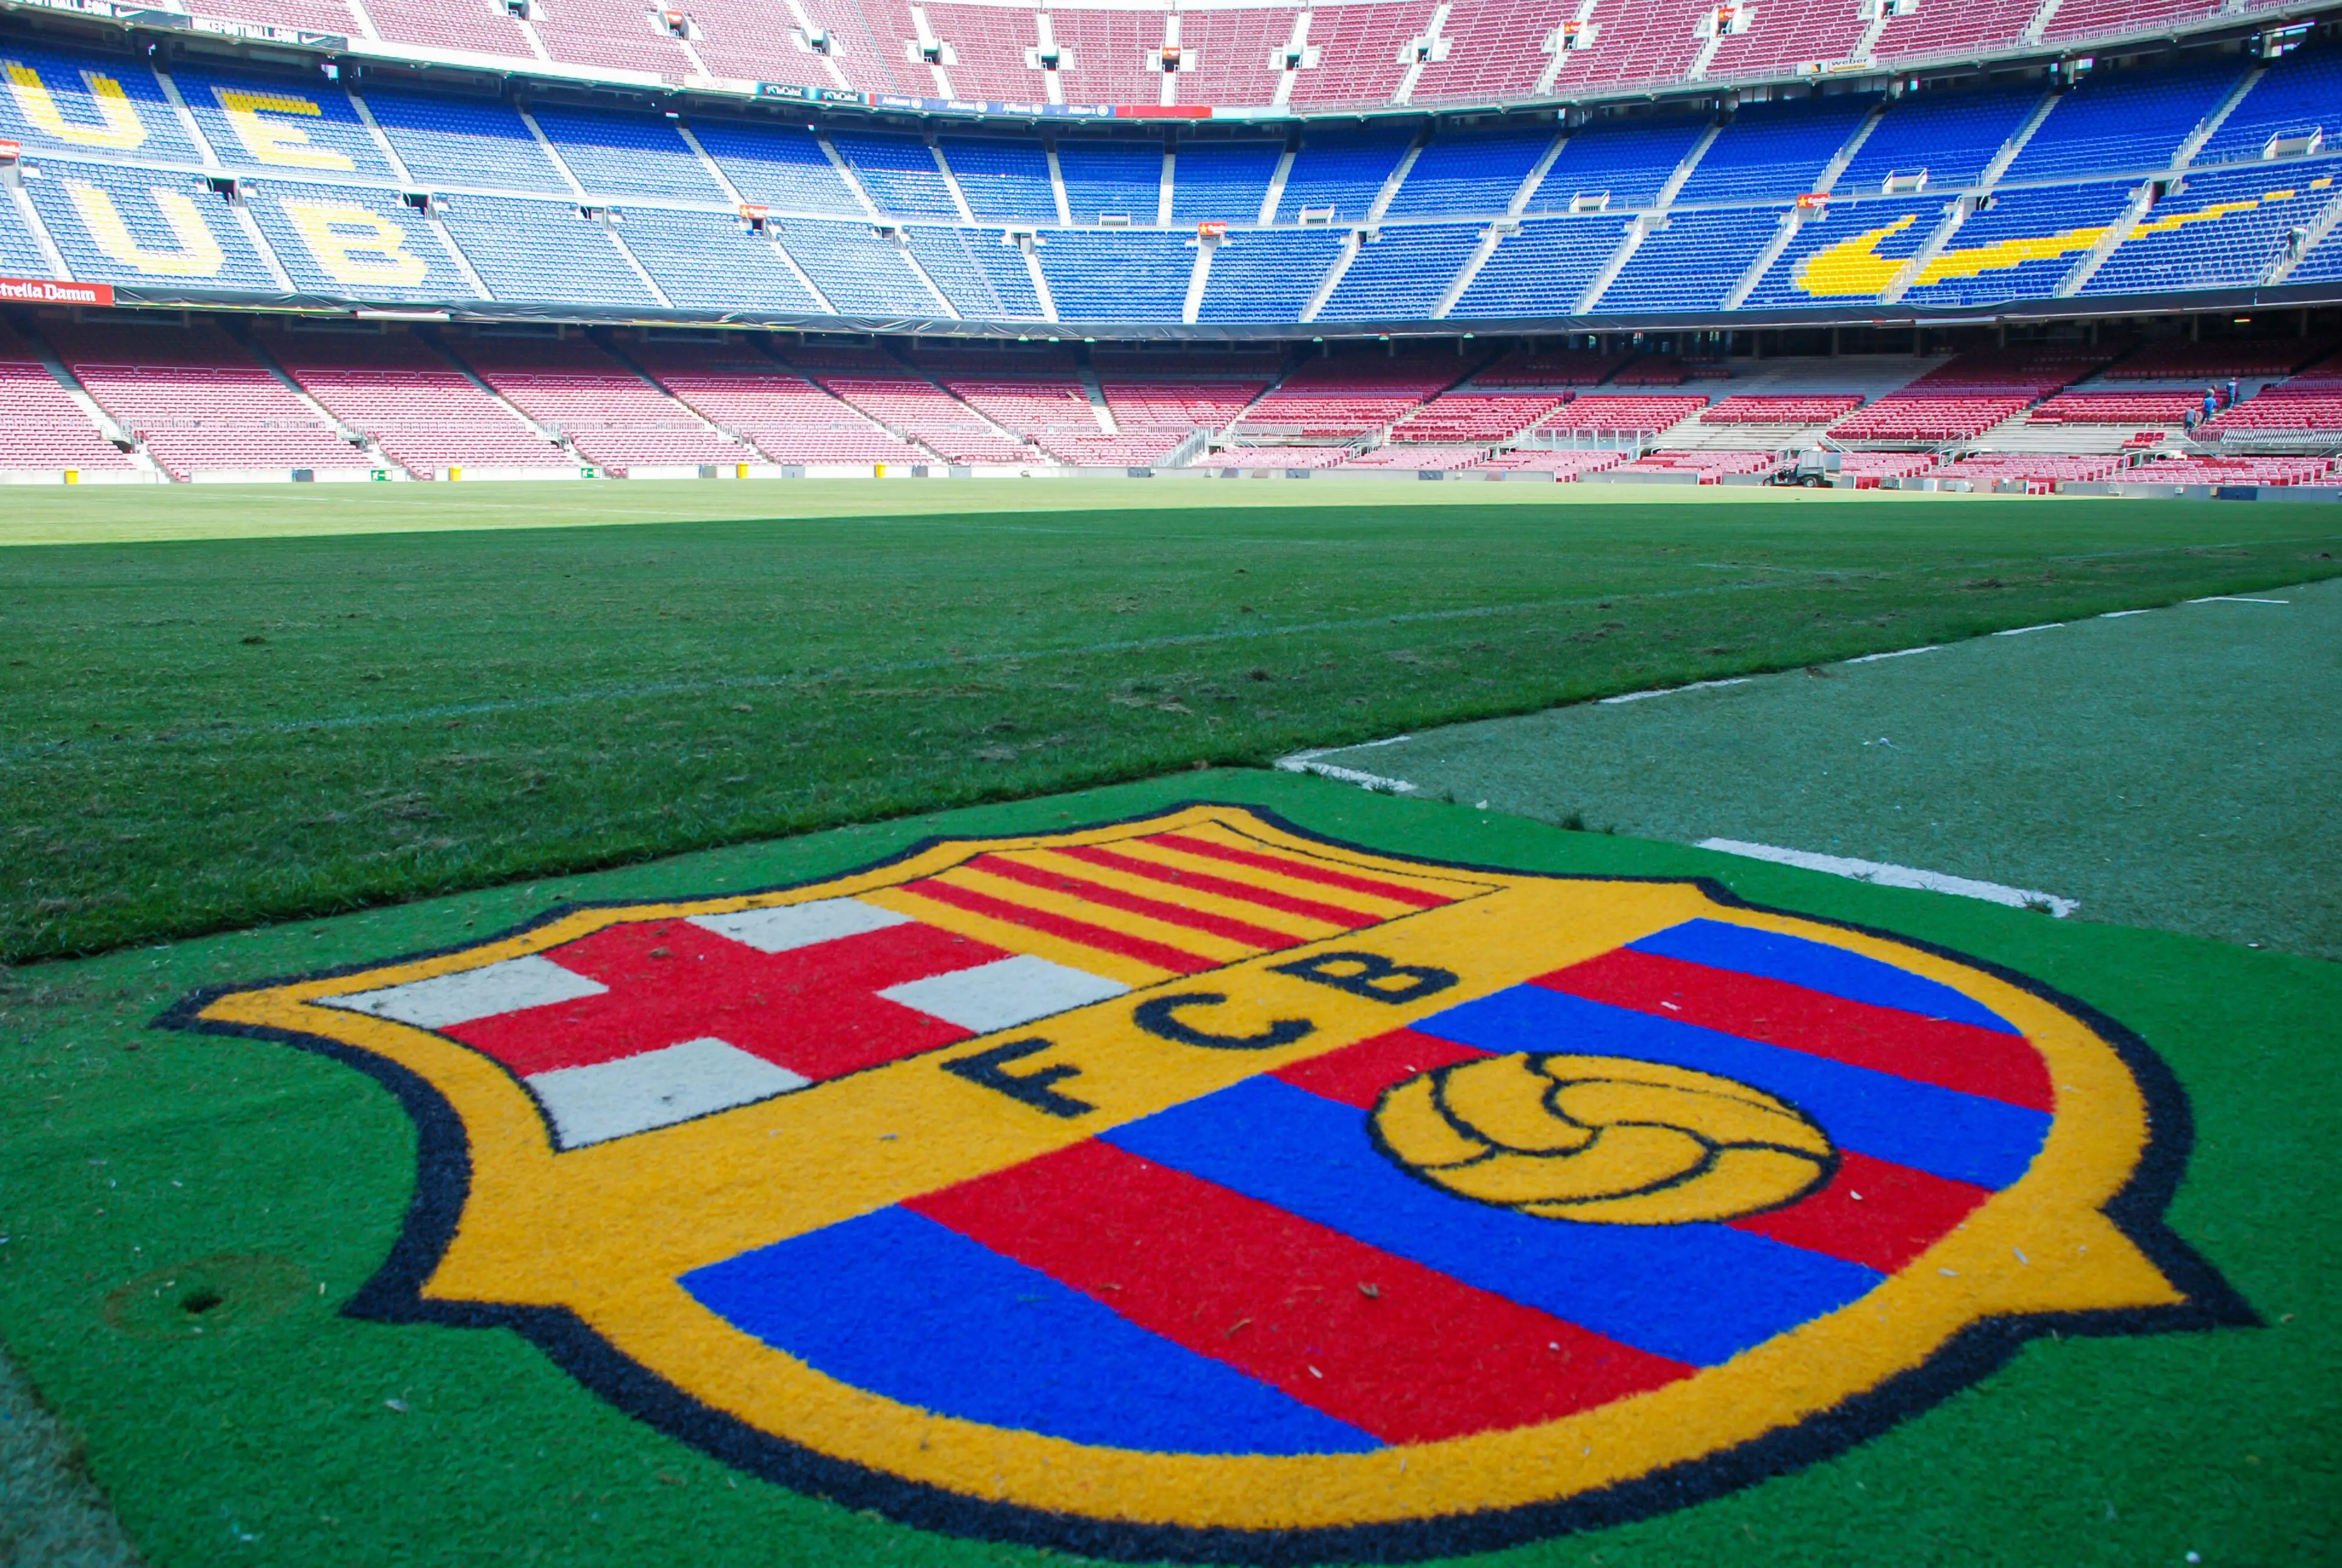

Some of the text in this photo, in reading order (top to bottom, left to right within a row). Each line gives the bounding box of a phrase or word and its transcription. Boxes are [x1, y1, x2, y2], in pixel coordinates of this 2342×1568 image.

[192, 16, 299, 44] NIKEFOOTBALL.COM
[883, 96, 910, 106] Allianz
[947, 101, 975, 110] Allianz
[1003, 103, 1031, 112] Allianz
[1068, 106, 1096, 115] Allianz
[43, 284, 96, 301] Damm
